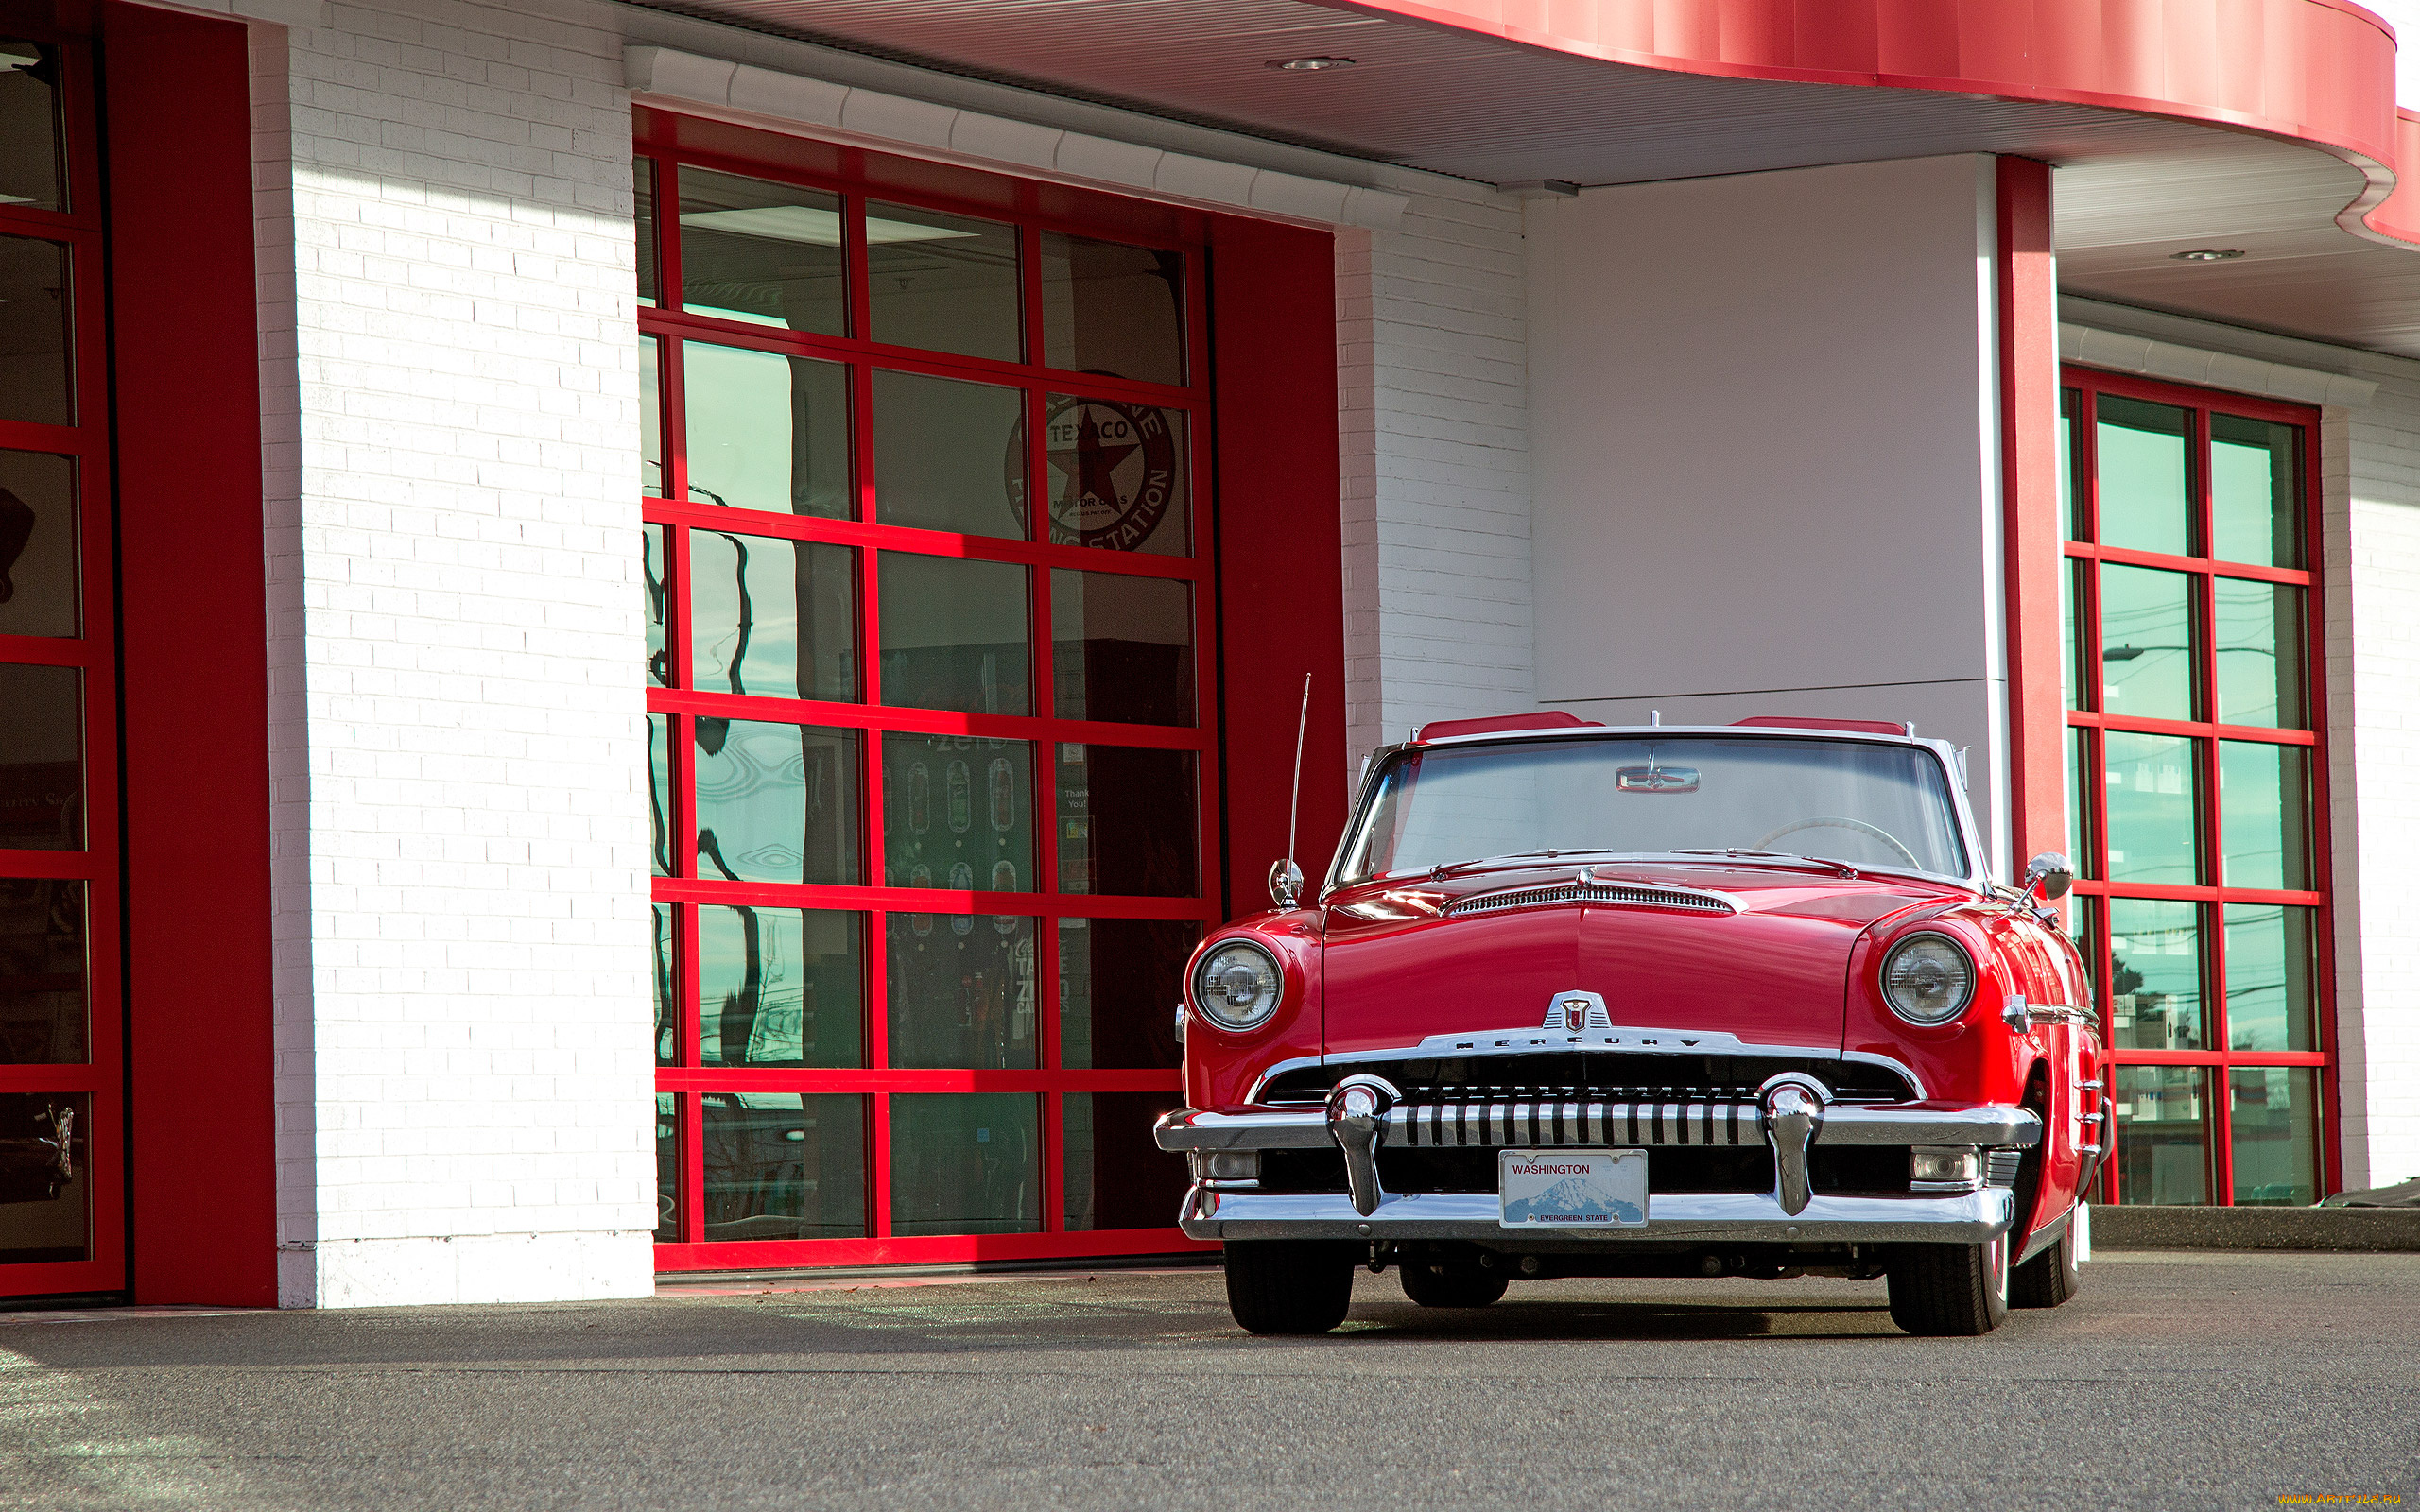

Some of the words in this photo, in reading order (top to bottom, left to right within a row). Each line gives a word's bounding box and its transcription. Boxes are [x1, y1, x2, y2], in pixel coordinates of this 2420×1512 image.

[1064, 788, 1090, 798] Thank
[1067, 799, 1087, 809] You!
[1456, 1037, 1701, 1050] MERCURY
[1512, 1164, 1590, 1175] WASHINGTON
